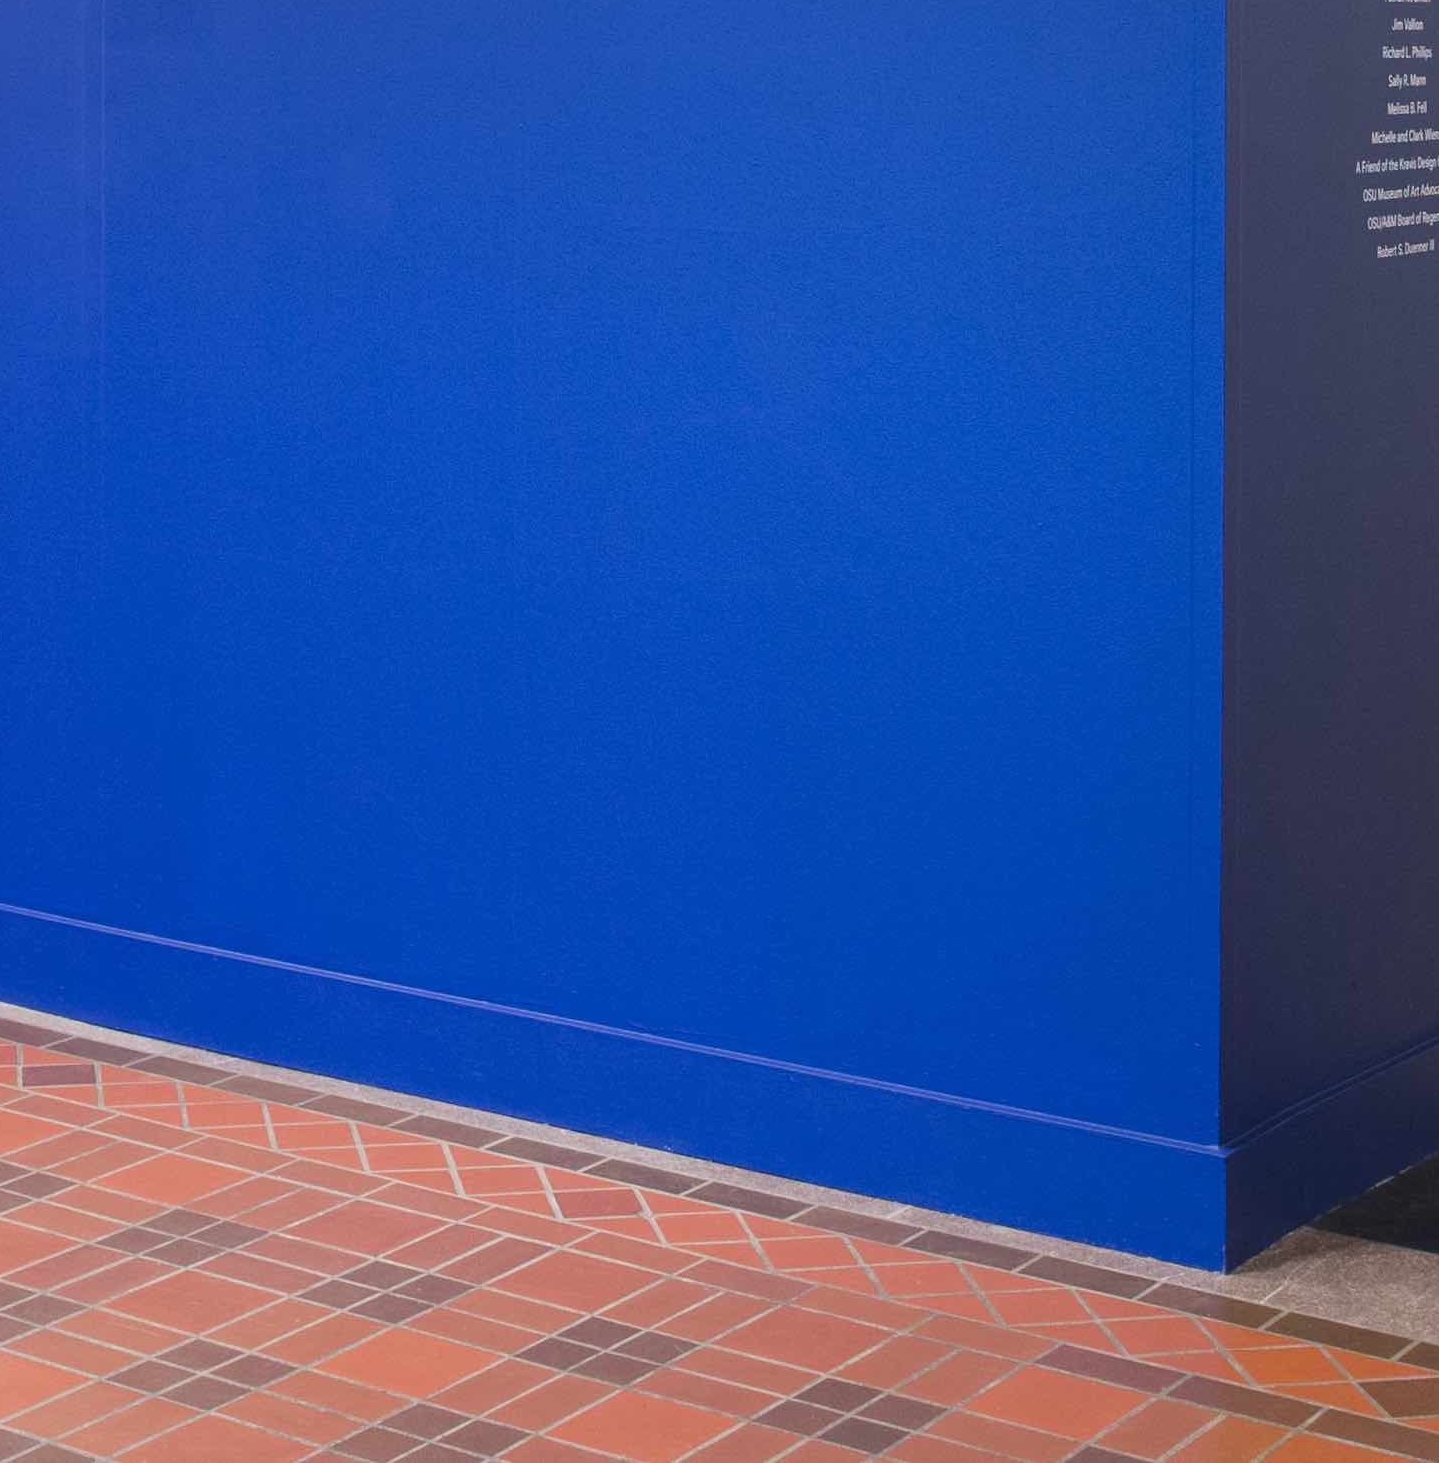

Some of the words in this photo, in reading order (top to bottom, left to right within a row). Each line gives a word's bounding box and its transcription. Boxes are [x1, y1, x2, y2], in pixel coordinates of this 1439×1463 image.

[1382, 45, 1404, 58] Richard
[1412, 45, 1432, 60] Phillips
[1387, 102, 1409, 115] Melissa
[1371, 131, 1396, 144] Michelle
[1397, 130, 1408, 143] and
[1409, 129, 1423, 141] Clark
[1355, 161, 1361, 174] A
[1362, 160, 1381, 173] Friend
[1381, 158, 1388, 172] of
[1388, 158, 1398, 170] the
[1399, 158, 1416, 170] Kravis
[1417, 156, 1437, 170] Design
[1363, 188, 1377, 202] OSU
[1377, 188, 1402, 200] Museum
[1403, 185, 1410, 198] of
[1410, 185, 1420, 197] Art
[1398, 213, 1415, 226] Board
[1416, 211, 1422, 225] of
[1377, 246, 1397, 258] Robert
